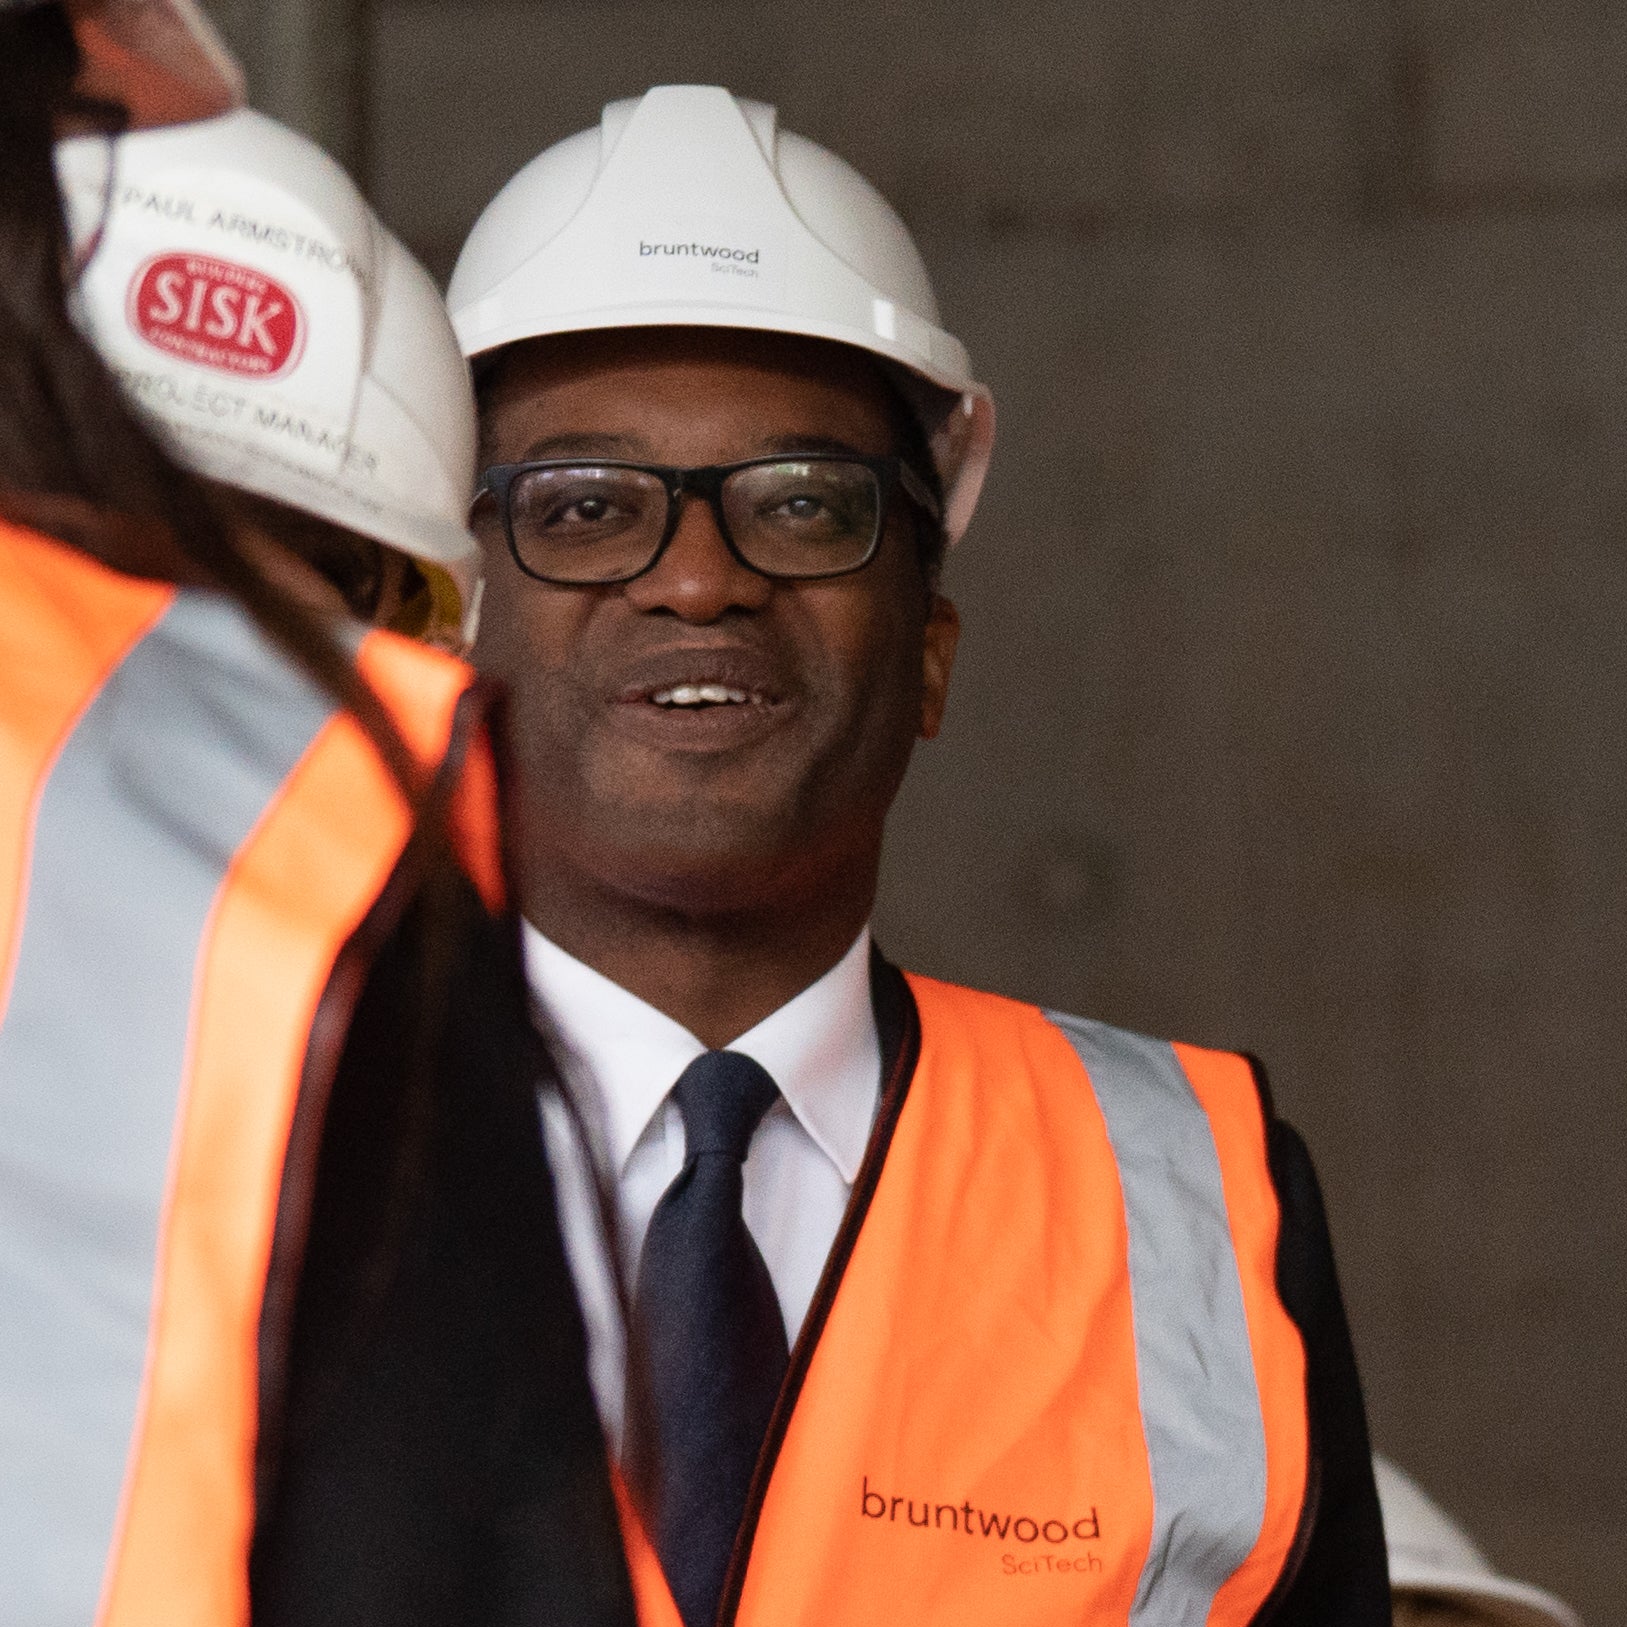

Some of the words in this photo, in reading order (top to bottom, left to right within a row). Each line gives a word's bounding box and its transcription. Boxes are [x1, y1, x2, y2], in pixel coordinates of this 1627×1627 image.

[122, 185, 195, 223] PAUL
[639, 240, 760, 264] bruntwood
[150, 269, 282, 356] SISK
[861, 1475, 1100, 1544] bruntwood
[1001, 1551, 1102, 1576] SciTech
